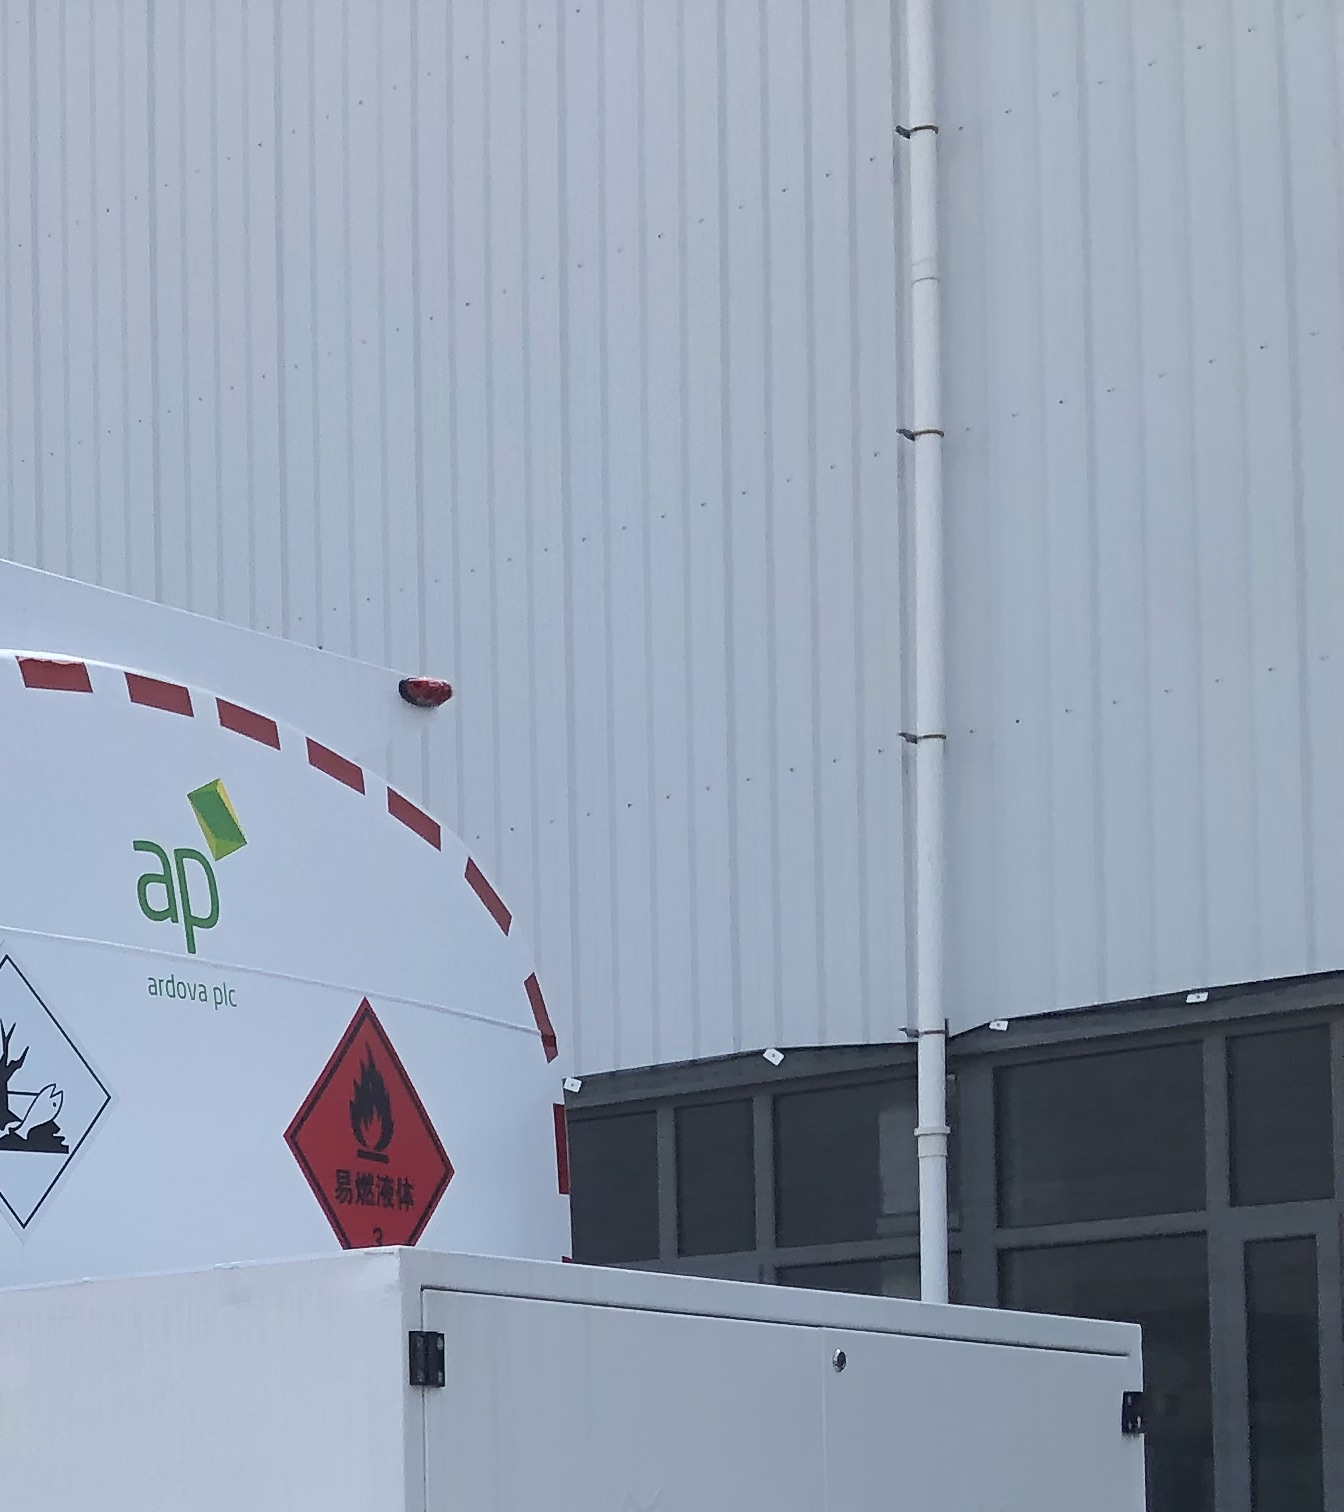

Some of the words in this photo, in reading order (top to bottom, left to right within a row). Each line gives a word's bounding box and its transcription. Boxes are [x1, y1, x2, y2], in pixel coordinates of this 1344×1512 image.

[132, 839, 220, 955] ap
[146, 973, 208, 1003] ardova
[212, 981, 239, 1011] plc
[334, 1169, 415, 1213] 易燃液体
